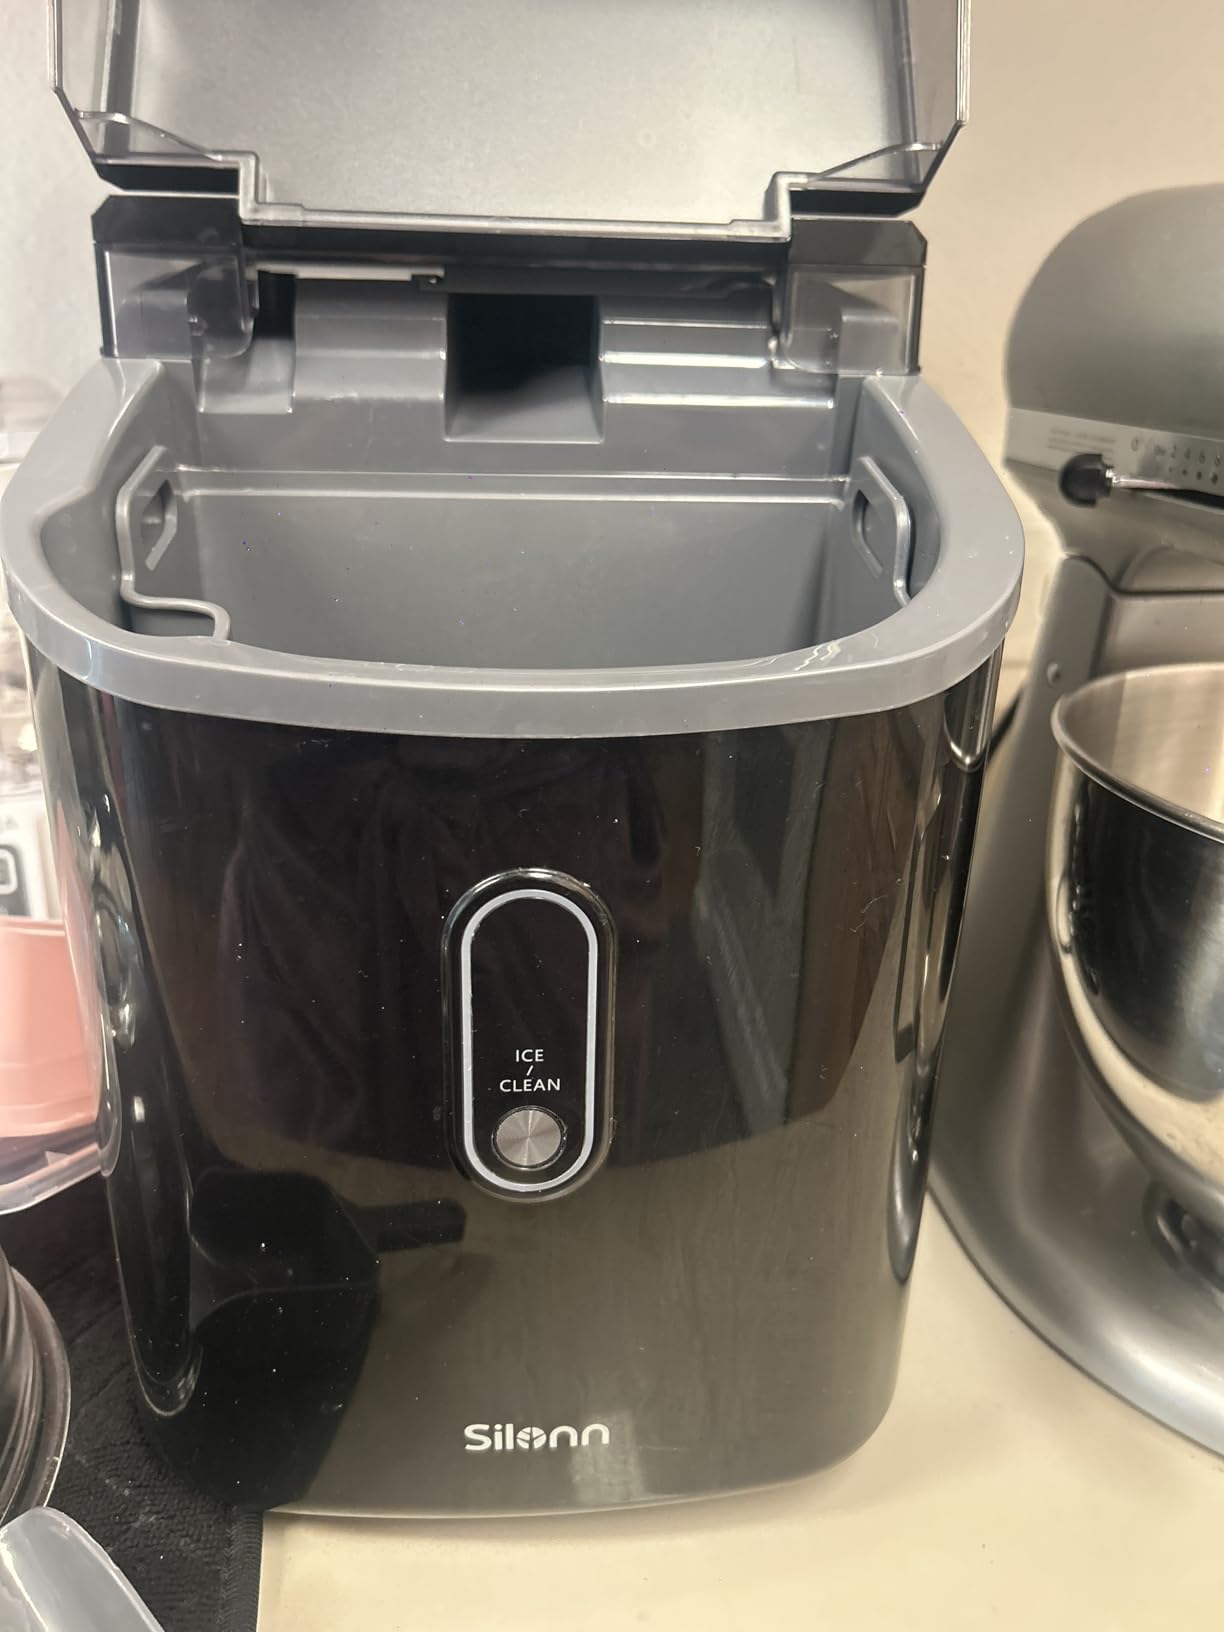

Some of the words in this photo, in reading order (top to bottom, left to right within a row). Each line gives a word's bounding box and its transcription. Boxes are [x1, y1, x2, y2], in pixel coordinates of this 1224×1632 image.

[515, 1048, 544, 1063] ICE
[526, 1065, 534, 1077] /
[499, 1078, 562, 1093] CLEAN
[464, 1423, 610, 1451] Silonn
